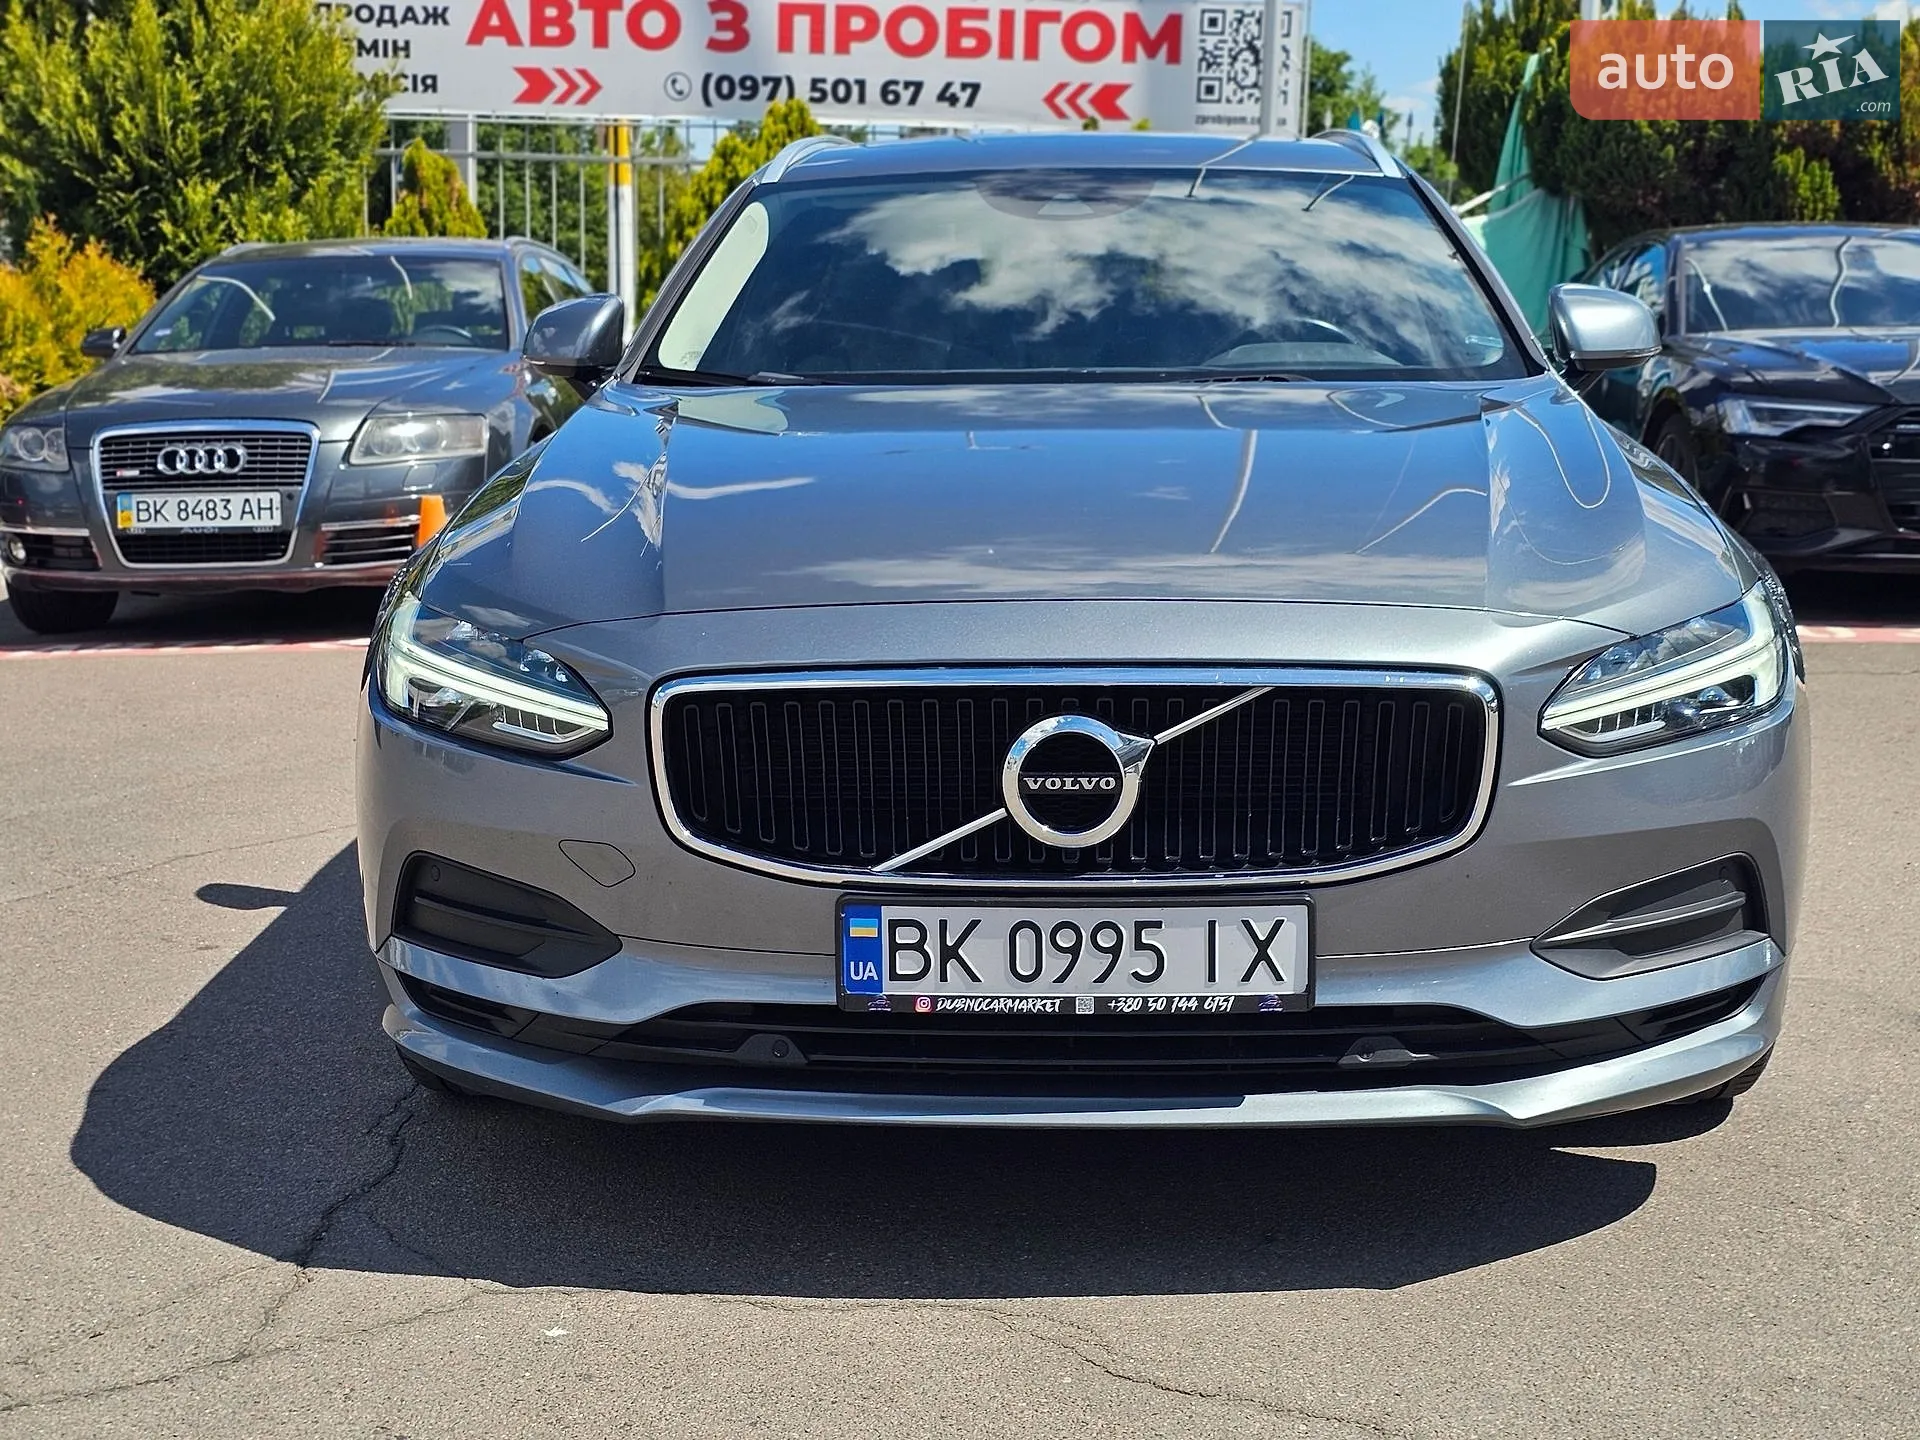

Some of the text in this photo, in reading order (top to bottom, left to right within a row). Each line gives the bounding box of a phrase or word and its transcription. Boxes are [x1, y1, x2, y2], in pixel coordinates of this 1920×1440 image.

[466, 0, 682, 51] АВТО
[777, 2, 1183, 65] ПРОБІГОМ
[342, 37, 411, 59] МІН
[701, 72, 981, 107] (097) 501 67 47
[136, 498, 275, 522] BK 8483 AH
[1023, 777, 1116, 790] VOLVO
[886, 918, 984, 984] BK
[1008, 919, 1166, 984] 0995
[850, 961, 879, 981] UA
[1107, 996, 1143, 1013] +380
[1147, 996, 1167, 1012] 50
